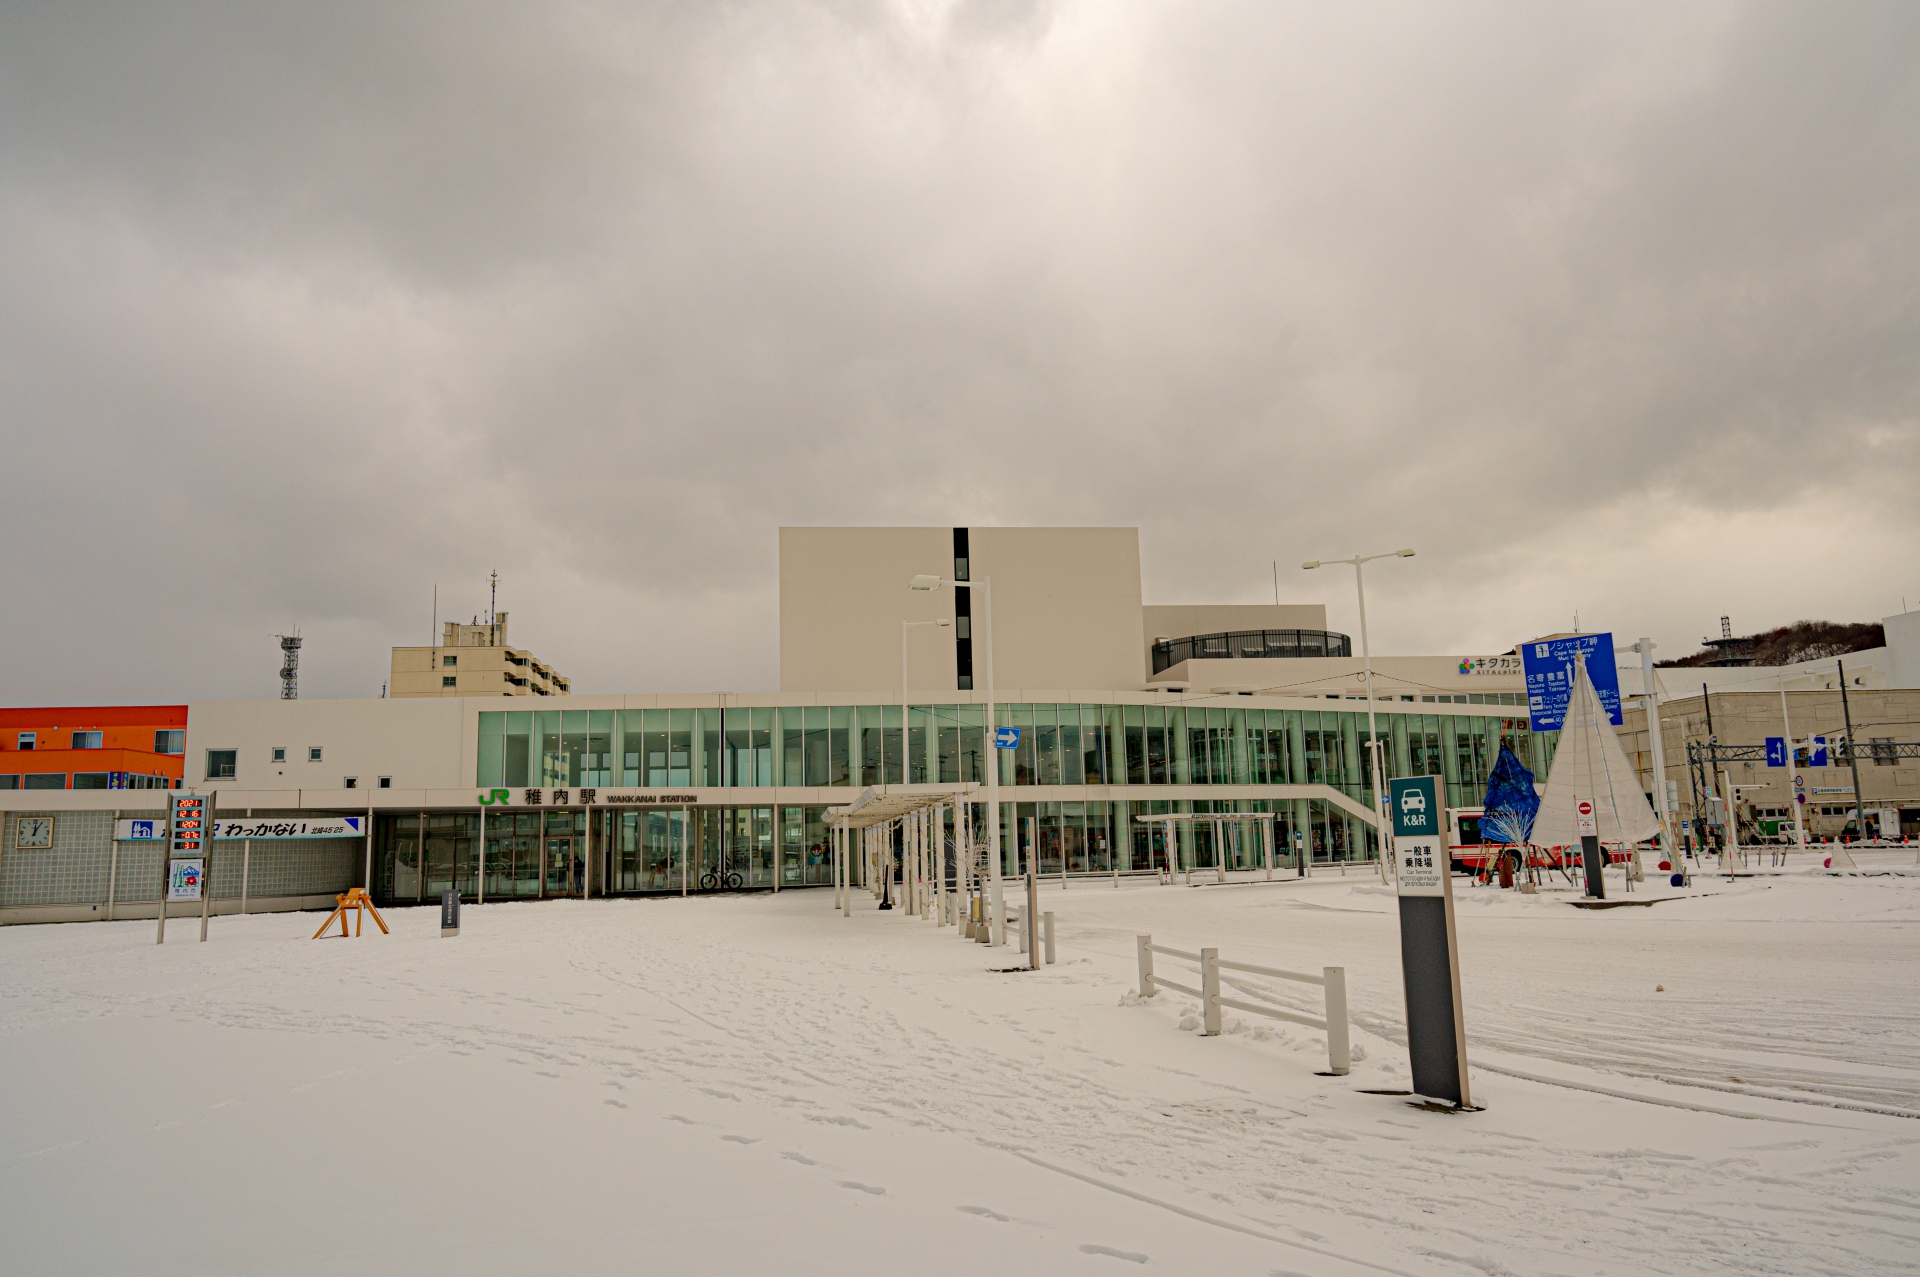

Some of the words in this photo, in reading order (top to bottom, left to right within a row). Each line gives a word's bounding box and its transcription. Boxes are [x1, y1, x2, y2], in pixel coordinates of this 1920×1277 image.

[1476, 658, 1521, 668] キタカラ
[478, 789, 510, 805] JR
[526, 788, 596, 804] 稚内駅
[1404, 814, 1426, 826] K&R
[225, 823, 306, 836] わっかない
[1404, 846, 1432, 856] 一般車
[1405, 858, 1432, 868] 乗降場
